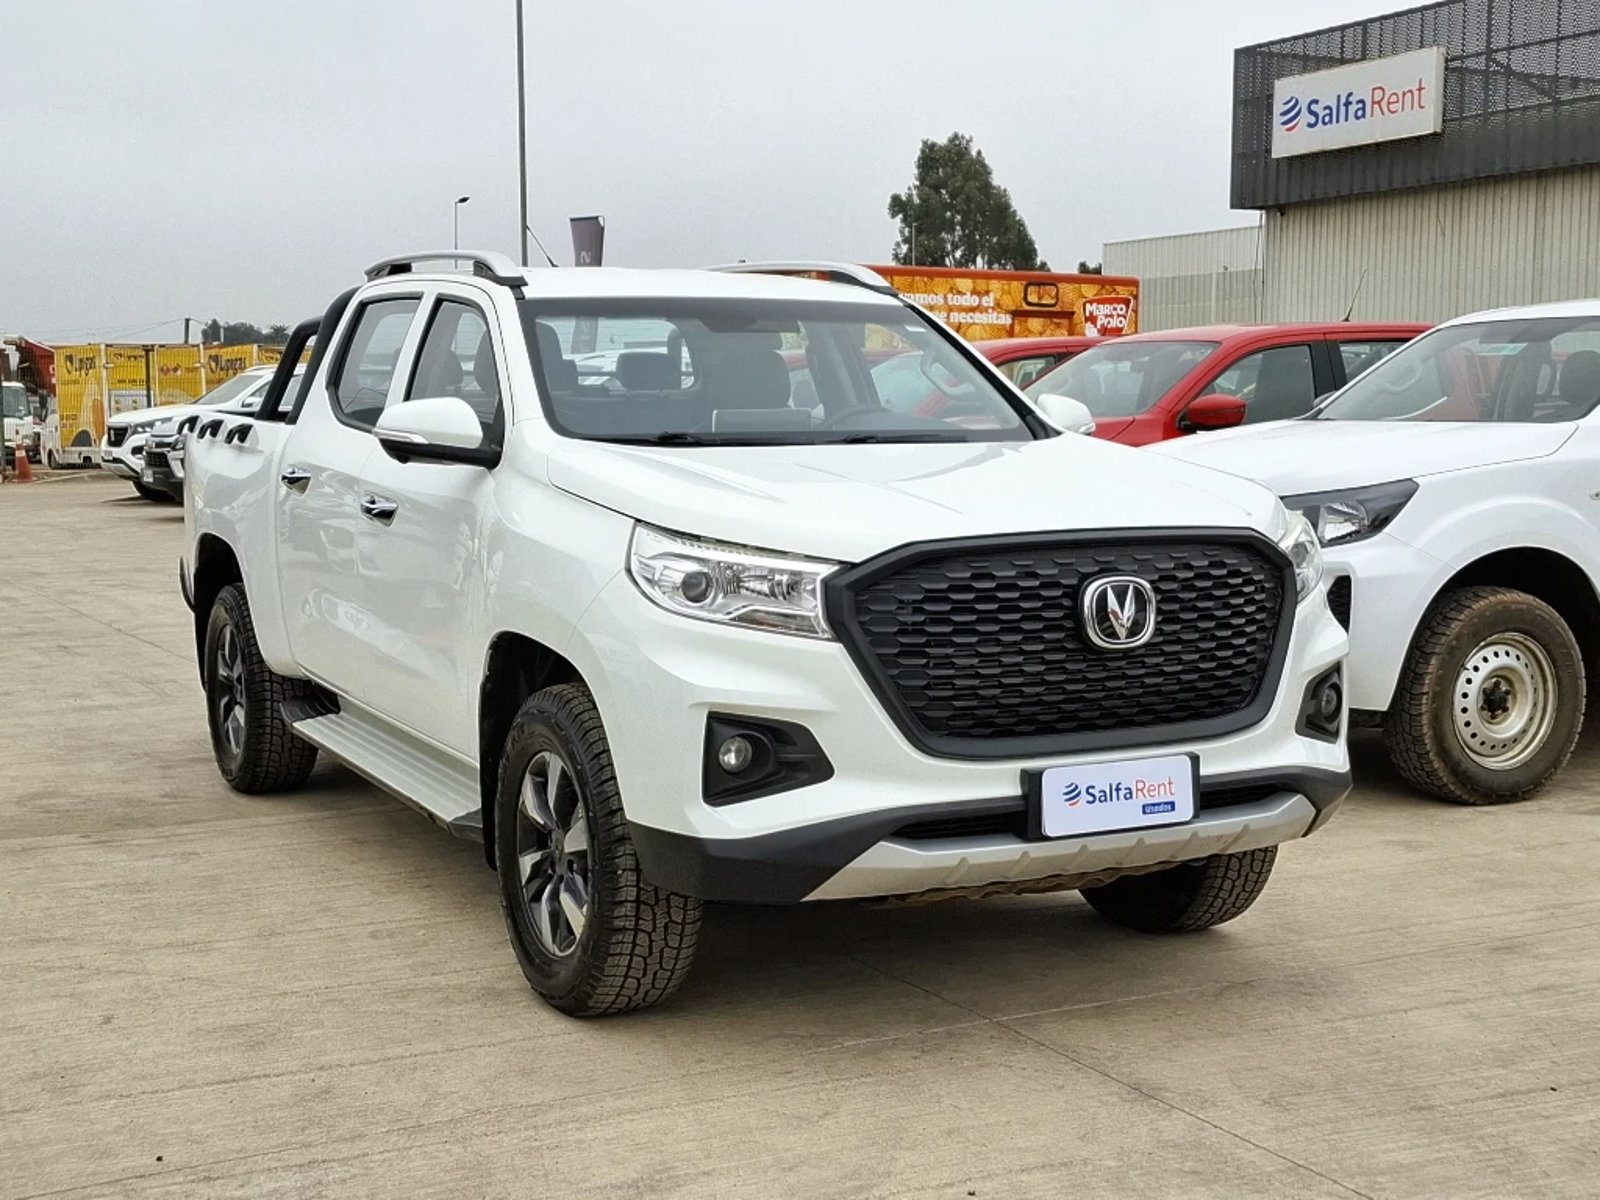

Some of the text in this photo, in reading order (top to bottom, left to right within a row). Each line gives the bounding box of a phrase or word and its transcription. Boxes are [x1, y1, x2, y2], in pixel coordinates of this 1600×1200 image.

[1305, 77, 1426, 129] SalfaRent
[946, 291, 980, 306] todo
[982, 292, 994, 307] el
[949, 308, 1013, 324] necesitas
[1096, 312, 1126, 329] Polo
[1085, 776, 1175, 805] SalfaRent
